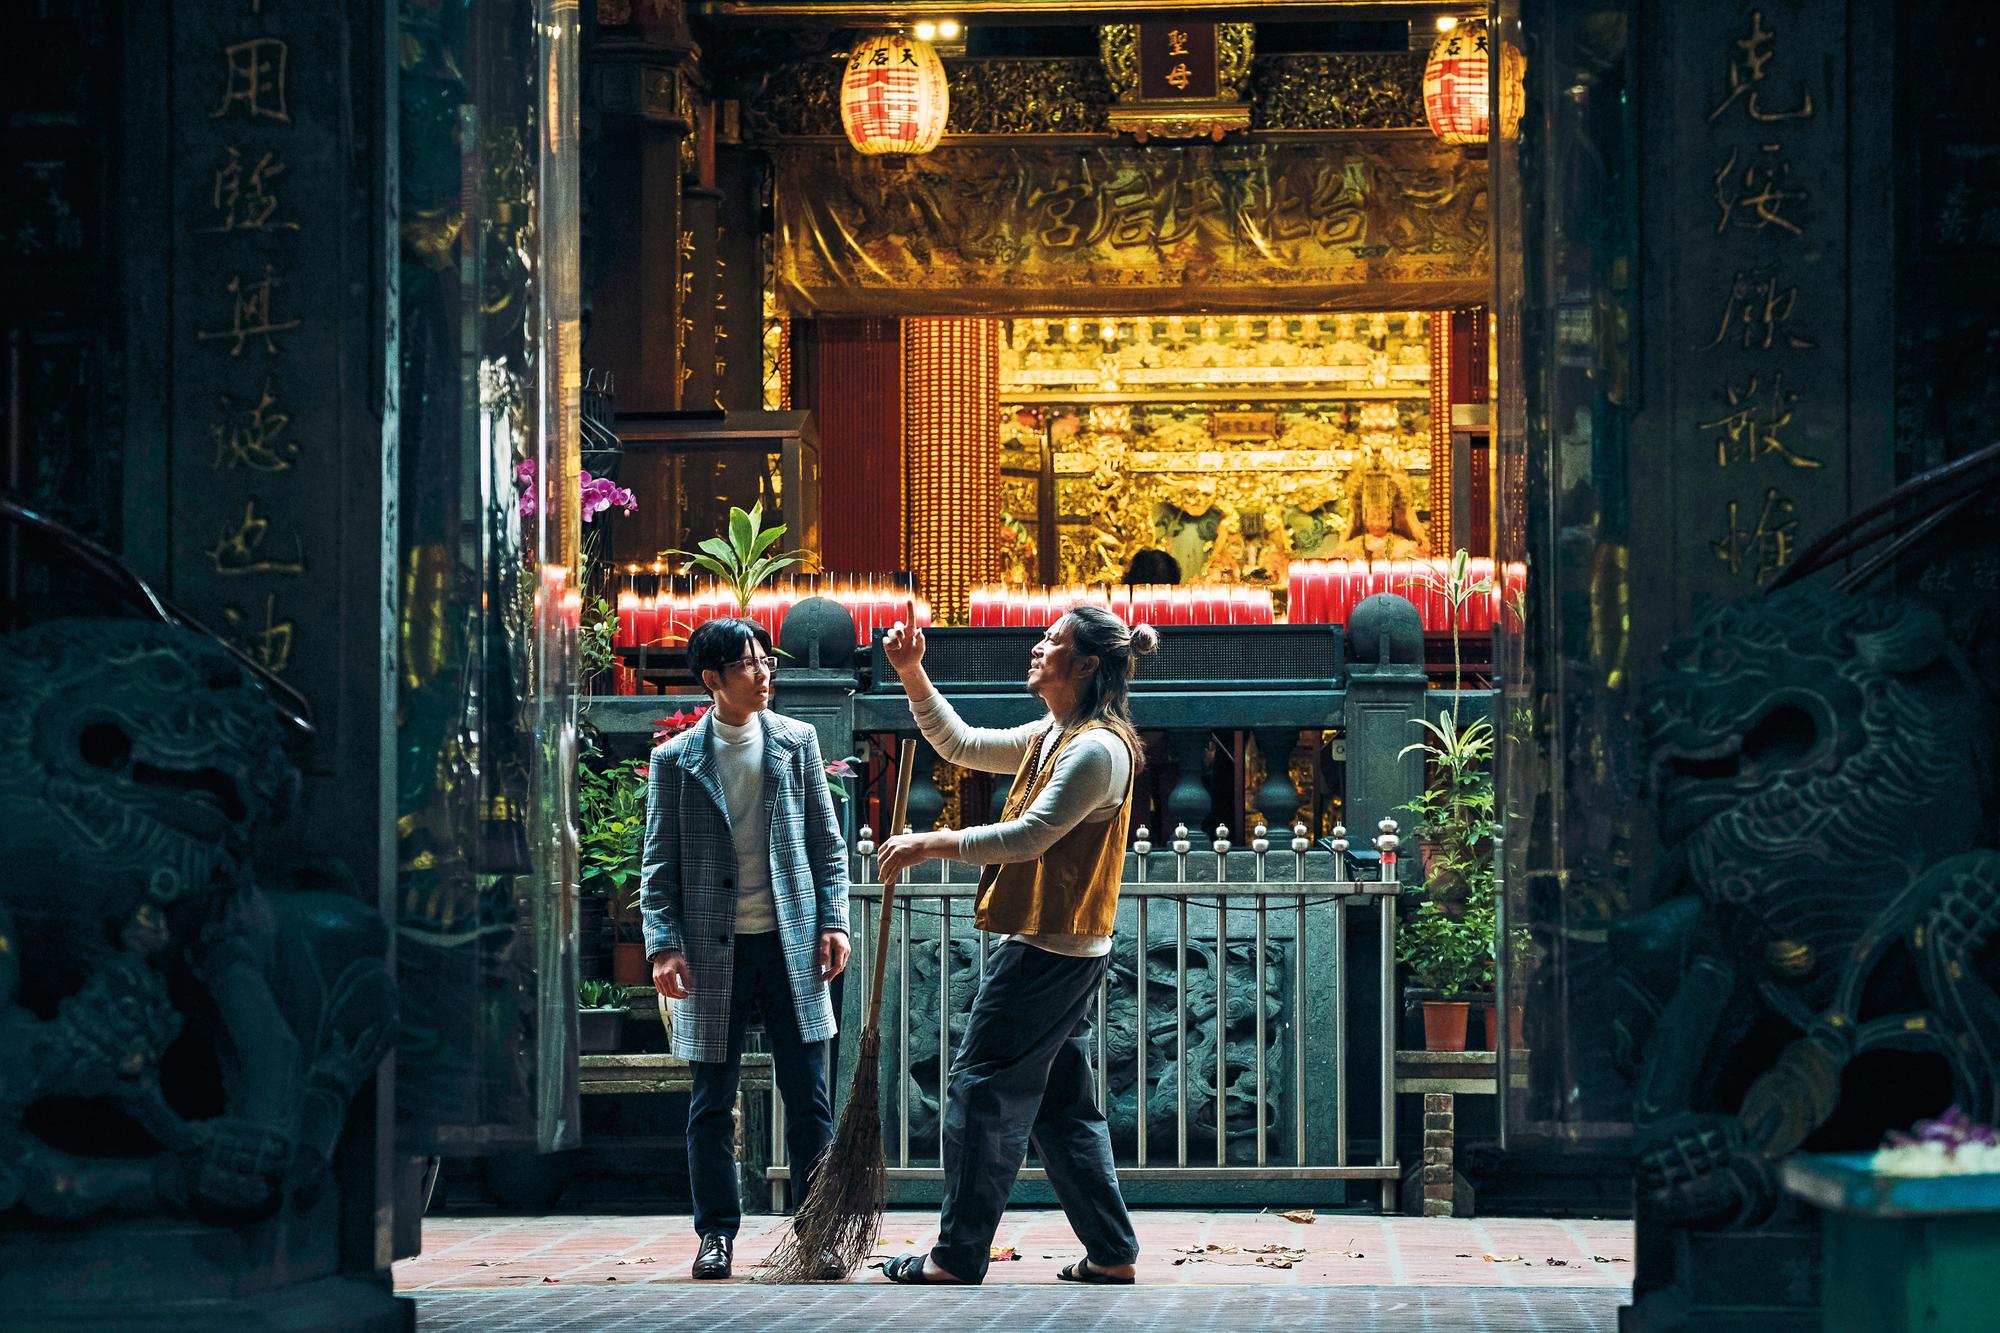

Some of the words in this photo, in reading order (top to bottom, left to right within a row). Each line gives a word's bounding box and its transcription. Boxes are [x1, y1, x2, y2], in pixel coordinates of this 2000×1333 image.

[850, 48, 918, 70] 天后宮
[1164, 28, 1192, 90] 聖母
